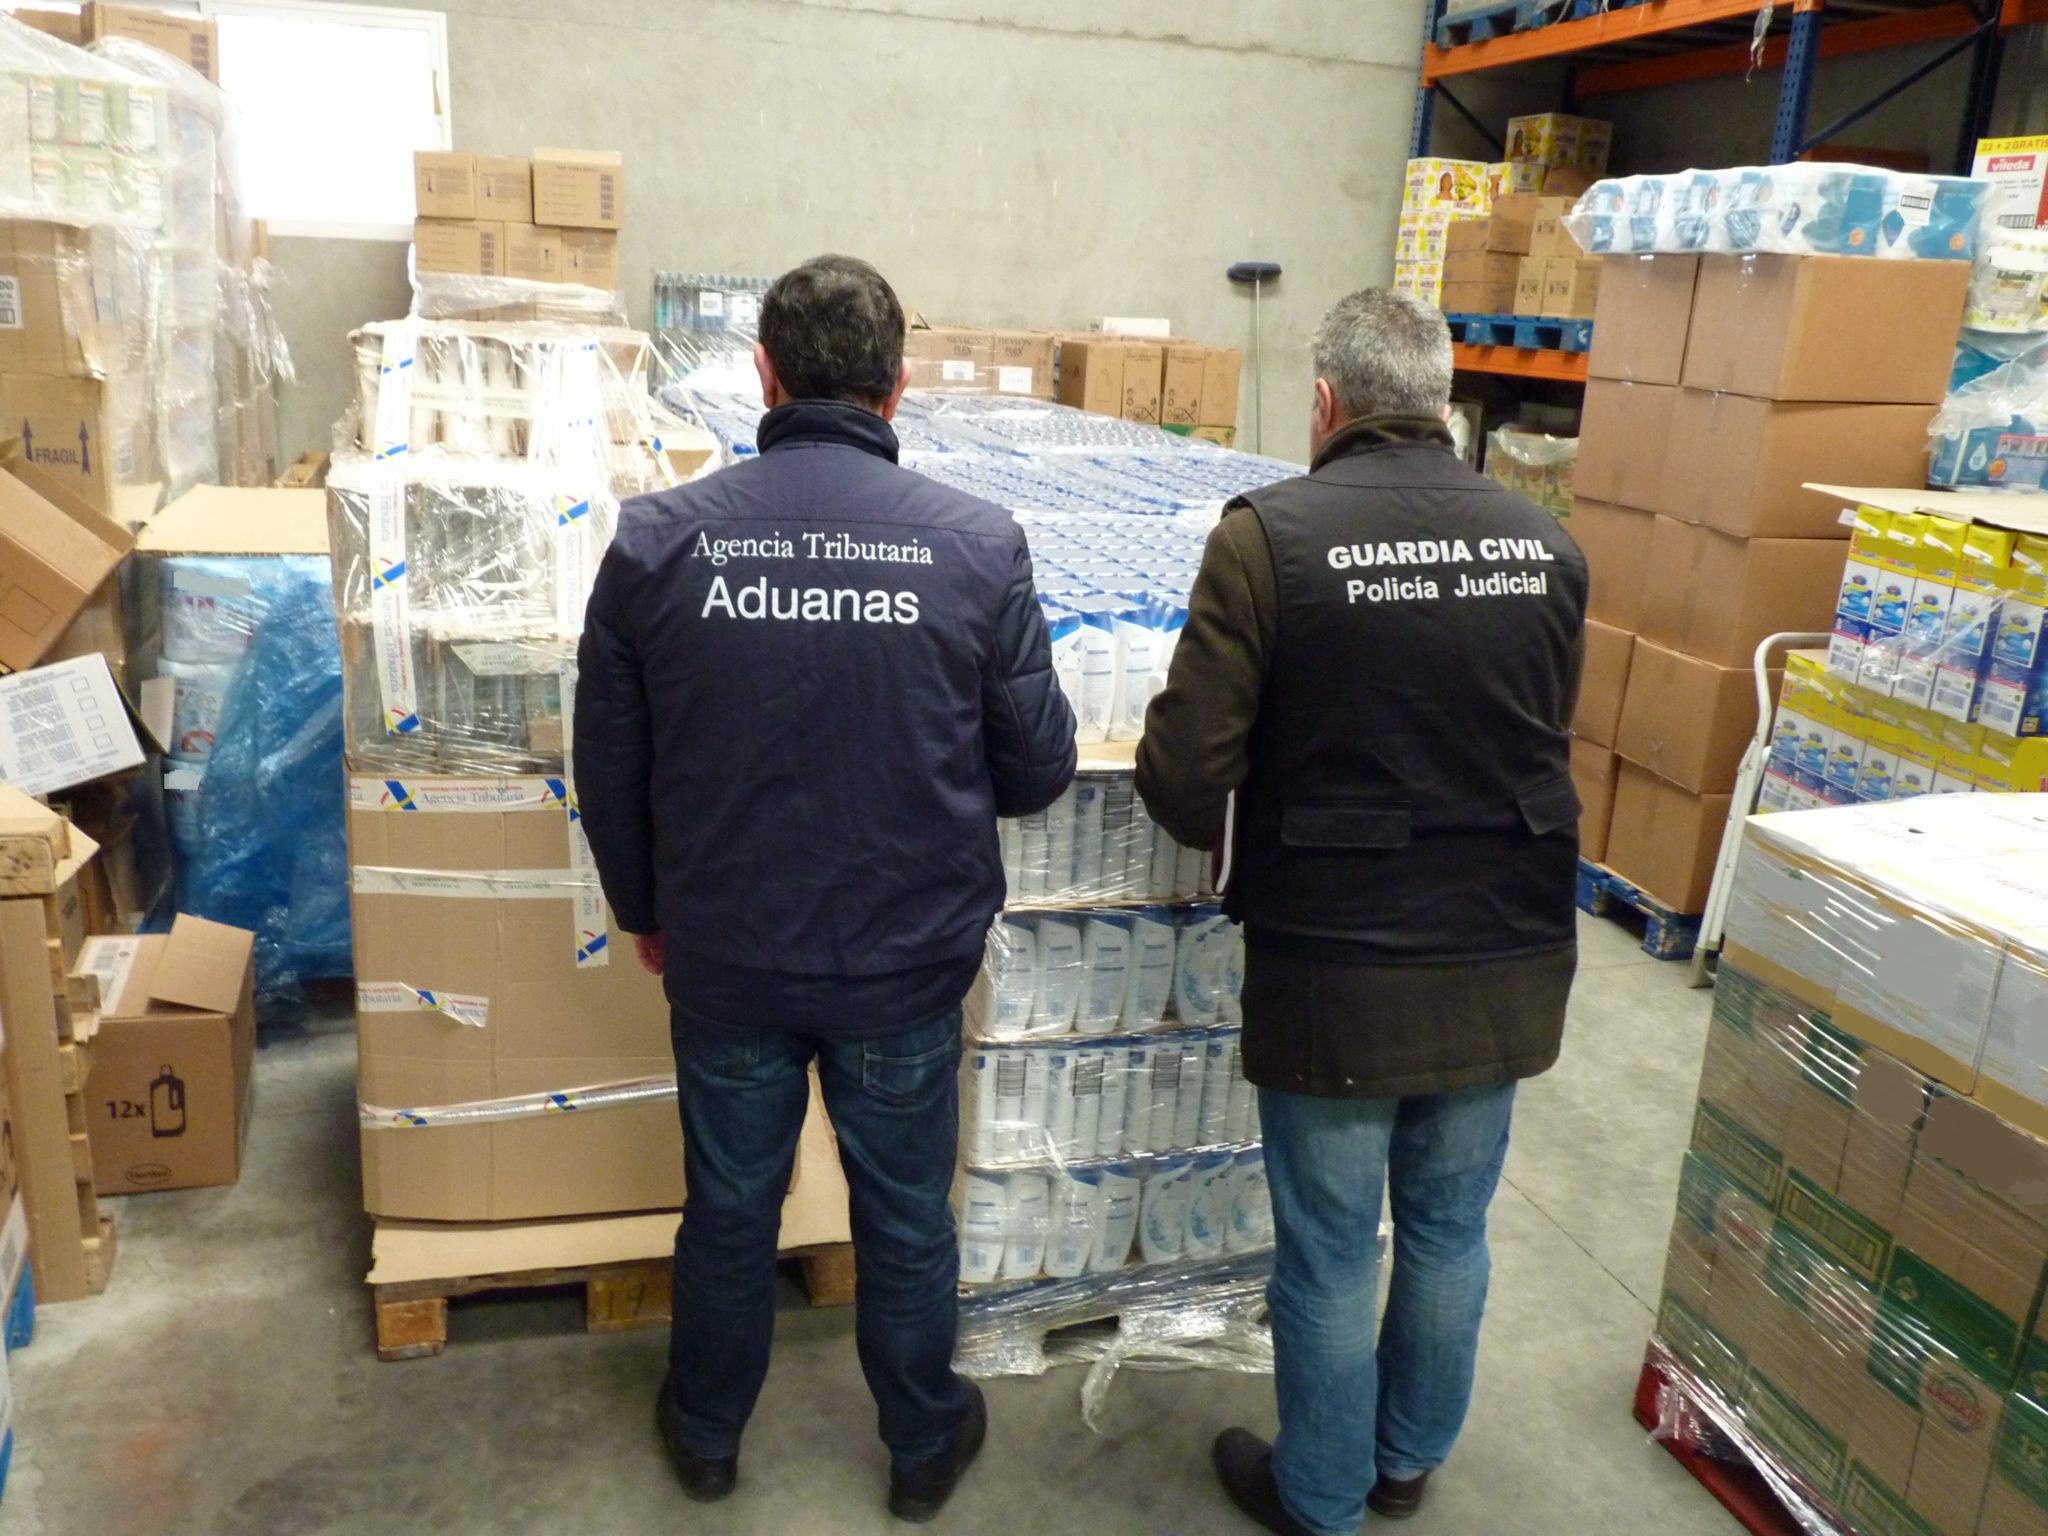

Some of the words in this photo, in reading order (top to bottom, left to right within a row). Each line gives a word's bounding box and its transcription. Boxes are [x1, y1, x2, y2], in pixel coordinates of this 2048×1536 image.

[1981, 142, 1994, 152] 22
[1991, 158, 2031, 171] vileda
[998, 336, 1033, 346] REVLON
[35, 449, 80, 464] FRAGIL
[690, 530, 795, 566] Agencia
[802, 531, 934, 565] Tributaria
[1327, 539, 1474, 569] GUARDIA
[1479, 538, 1554, 561] CIVIL
[1346, 576, 1440, 604] Policía
[1453, 572, 1548, 598] Judicial
[701, 575, 920, 624] Aduanas
[421, 792, 466, 805] Agencia
[470, 792, 525, 804] Tributaria
[105, 1101, 147, 1119] 12x
